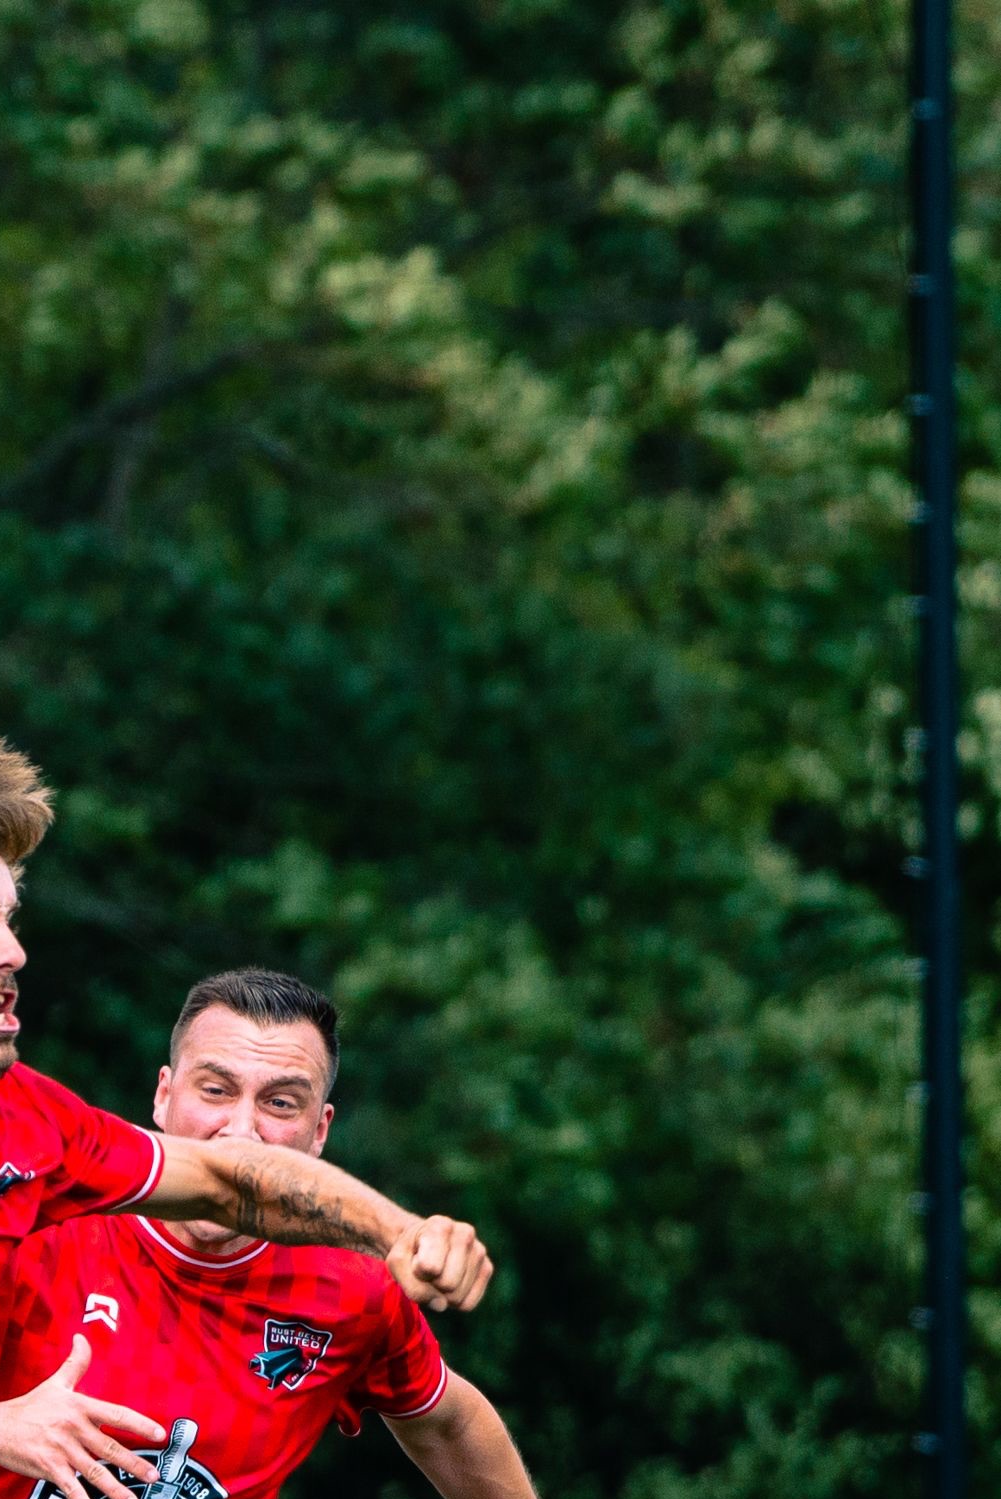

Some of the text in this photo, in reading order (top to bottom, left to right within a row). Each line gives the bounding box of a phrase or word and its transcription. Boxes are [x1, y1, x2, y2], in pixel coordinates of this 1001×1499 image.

[270, 1333, 320, 1349] UNITED
[271, 1326, 321, 1341] RUST BELT
